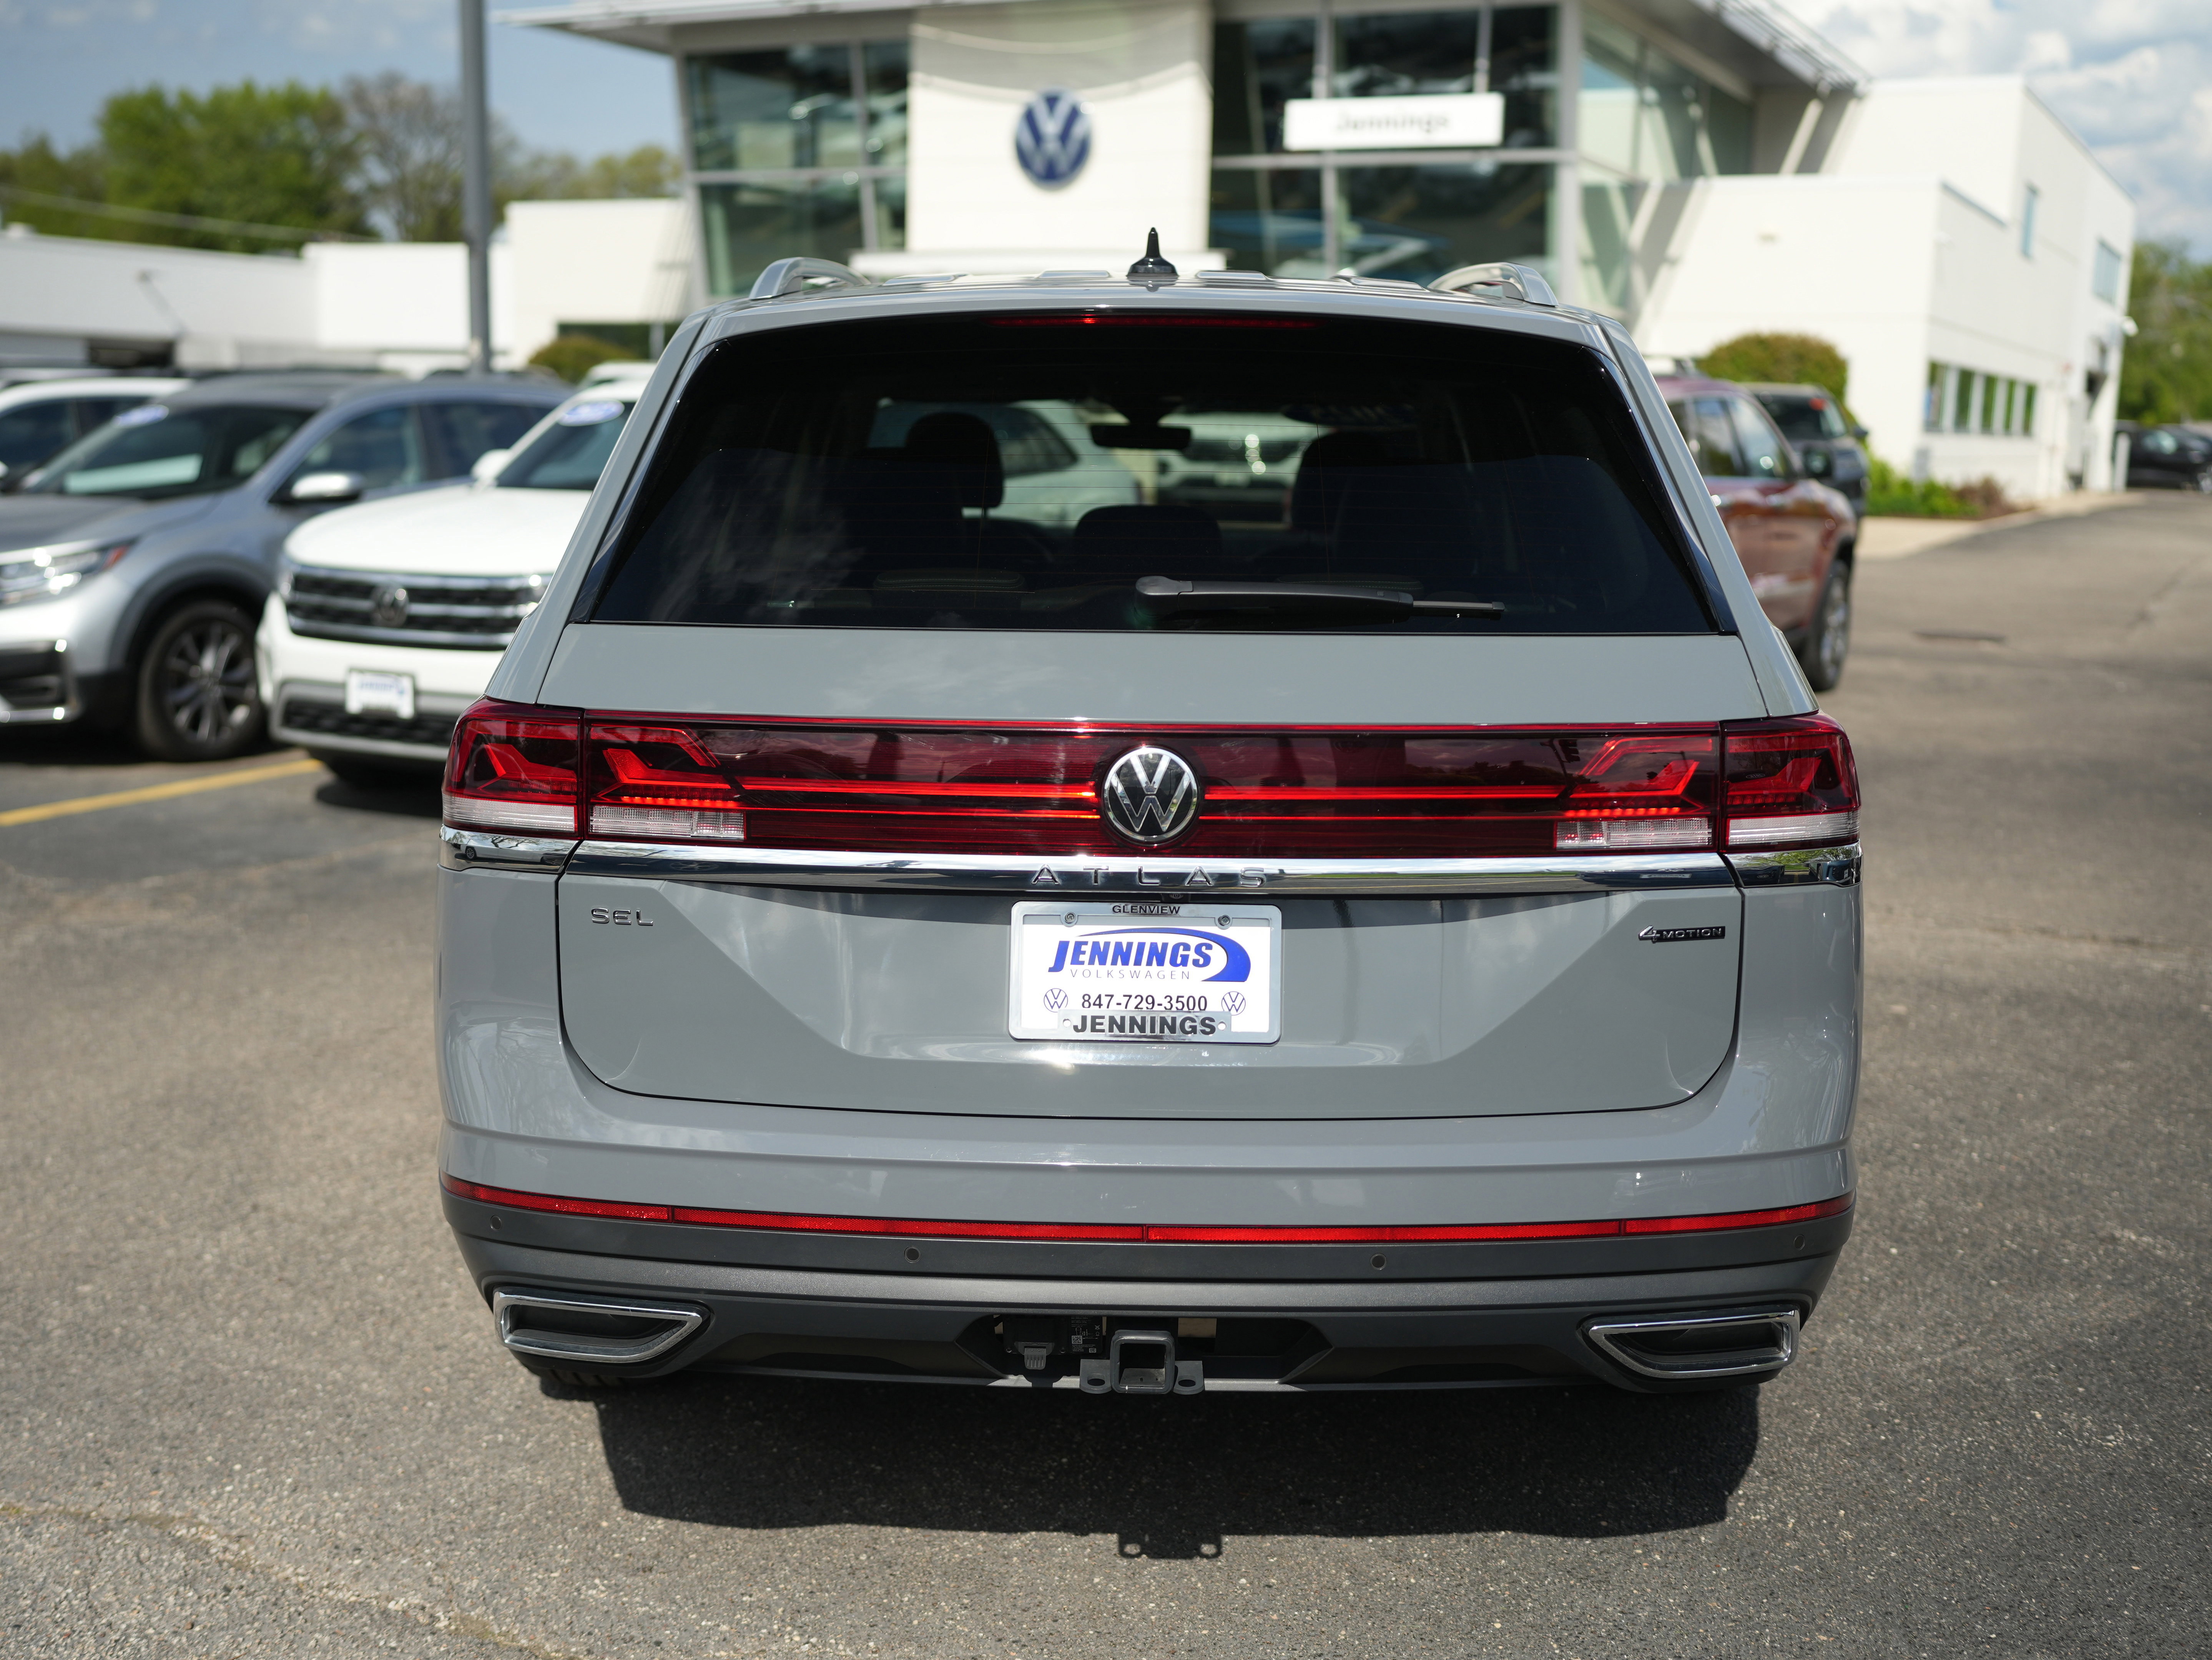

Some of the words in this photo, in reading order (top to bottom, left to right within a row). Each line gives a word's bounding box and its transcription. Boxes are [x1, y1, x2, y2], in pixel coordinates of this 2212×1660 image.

[1031, 864, 1266, 887] ATLAS
[591, 908, 653, 926] SEL
[1112, 905, 1180, 914] GLENVIEW
[1638, 925, 1722, 943] 4MOTION
[1048, 940, 1213, 973] JENNINGS
[1070, 969, 1190, 980] VOLKSWAGEN
[1081, 993, 1207, 1011] 847-729-3500
[1073, 1015, 1216, 1035] JENNINGS
